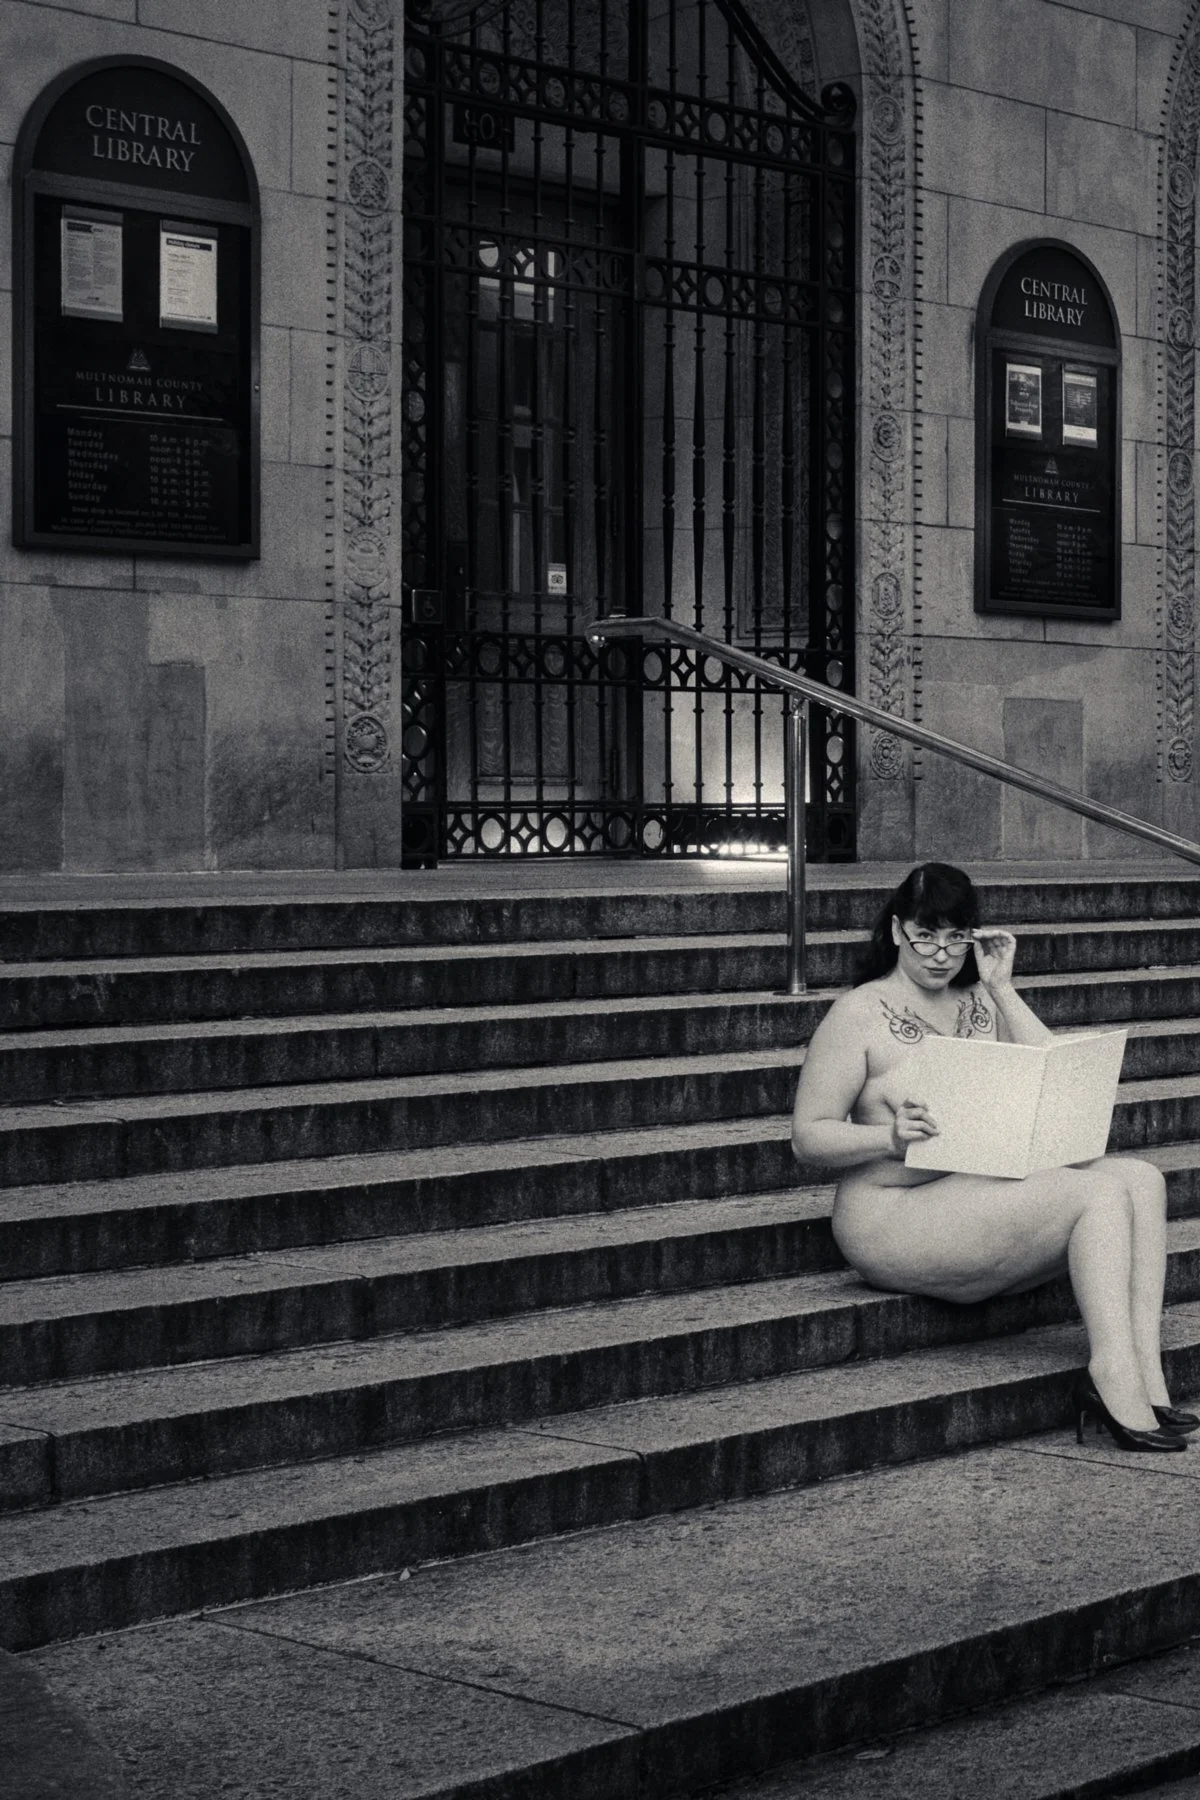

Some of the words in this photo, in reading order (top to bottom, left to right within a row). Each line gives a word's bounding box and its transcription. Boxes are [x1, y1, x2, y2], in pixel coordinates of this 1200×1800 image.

[85, 104, 202, 145] CENTRAL
[91, 134, 196, 173] LIBRARY
[1020, 276, 1088, 306] CENTRAL
[1024, 299, 1085, 326] LIBRARY
[75, 371, 152, 387] MULTNOMAH
[156, 378, 204, 392] COUNTY
[95, 386, 187, 409] LIBRARY
[67, 426, 104, 440] Monday
[68, 437, 104, 451] Tuesday
[68, 448, 119, 462] Wednesday
[68, 458, 108, 472] Thursday
[67, 469, 95, 482] Friday
[68, 480, 108, 493] Saturday
[68, 491, 101, 504] Sunday
[1024, 486, 1079, 504] LIBRARY
